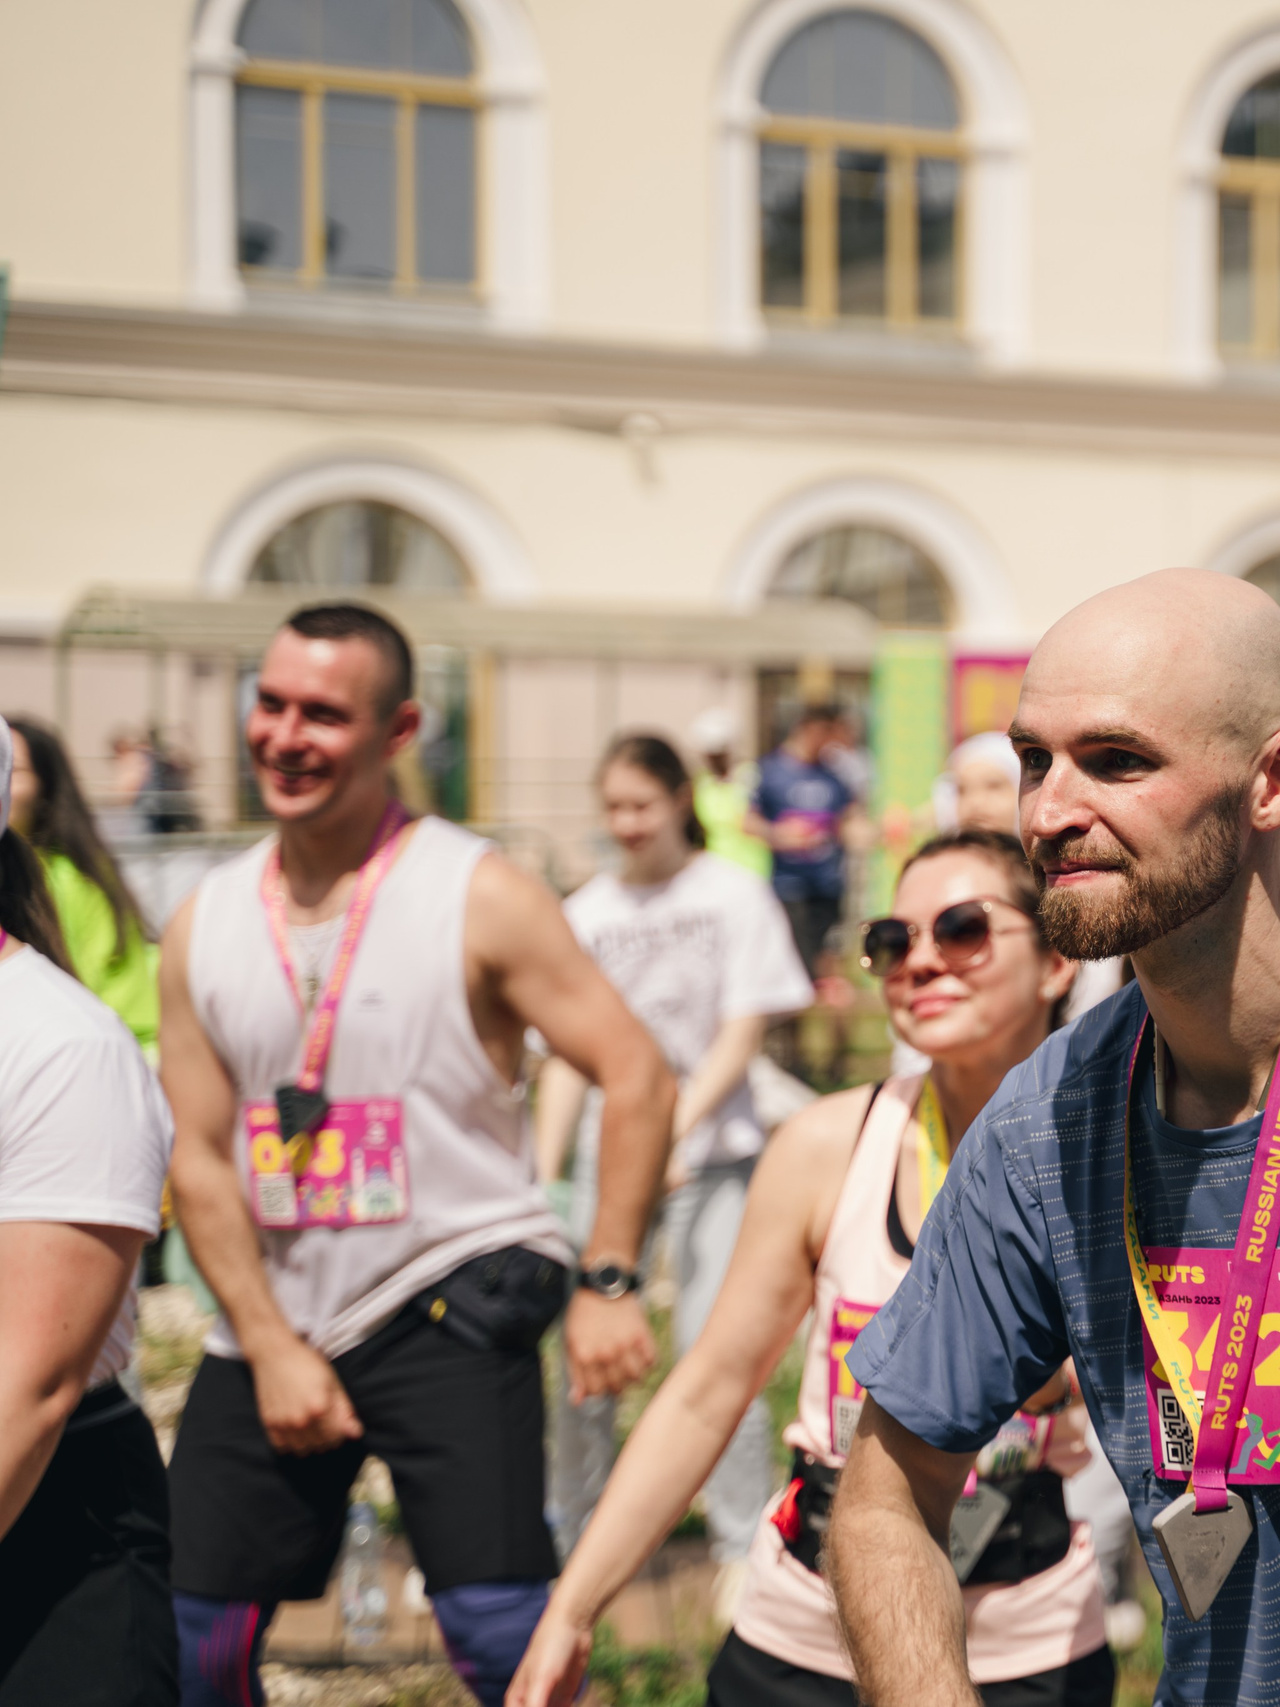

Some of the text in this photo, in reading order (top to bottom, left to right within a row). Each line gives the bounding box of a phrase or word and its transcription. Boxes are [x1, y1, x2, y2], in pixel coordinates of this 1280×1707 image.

[1127, 1212, 1160, 1320] КАЗАНИ
[1148, 1264, 1206, 1284] RUTS
[1159, 1294, 1221, 1305] АЗАНЬ 2023
[1211, 1294, 1253, 1430] RUTS 2023
